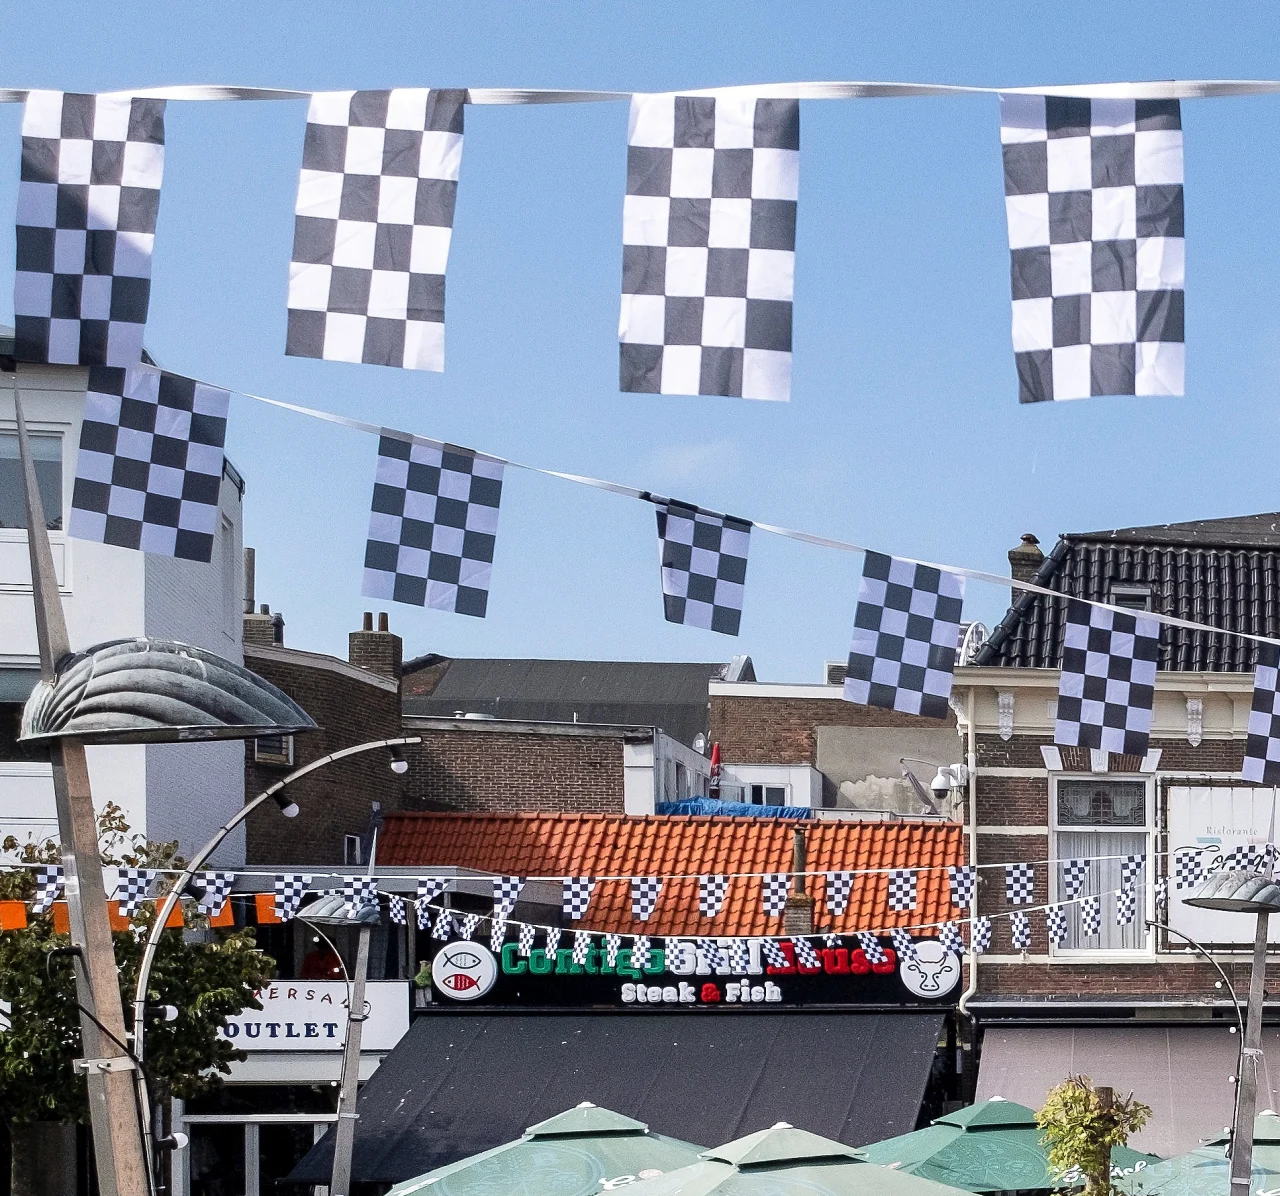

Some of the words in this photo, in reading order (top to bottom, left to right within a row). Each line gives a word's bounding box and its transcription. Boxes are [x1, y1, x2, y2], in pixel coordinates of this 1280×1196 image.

[621, 981, 696, 1003] Steak
[701, 983, 721, 1003] &
[726, 979, 783, 1003] Fish
[223, 1022, 339, 1038] OUTLET
